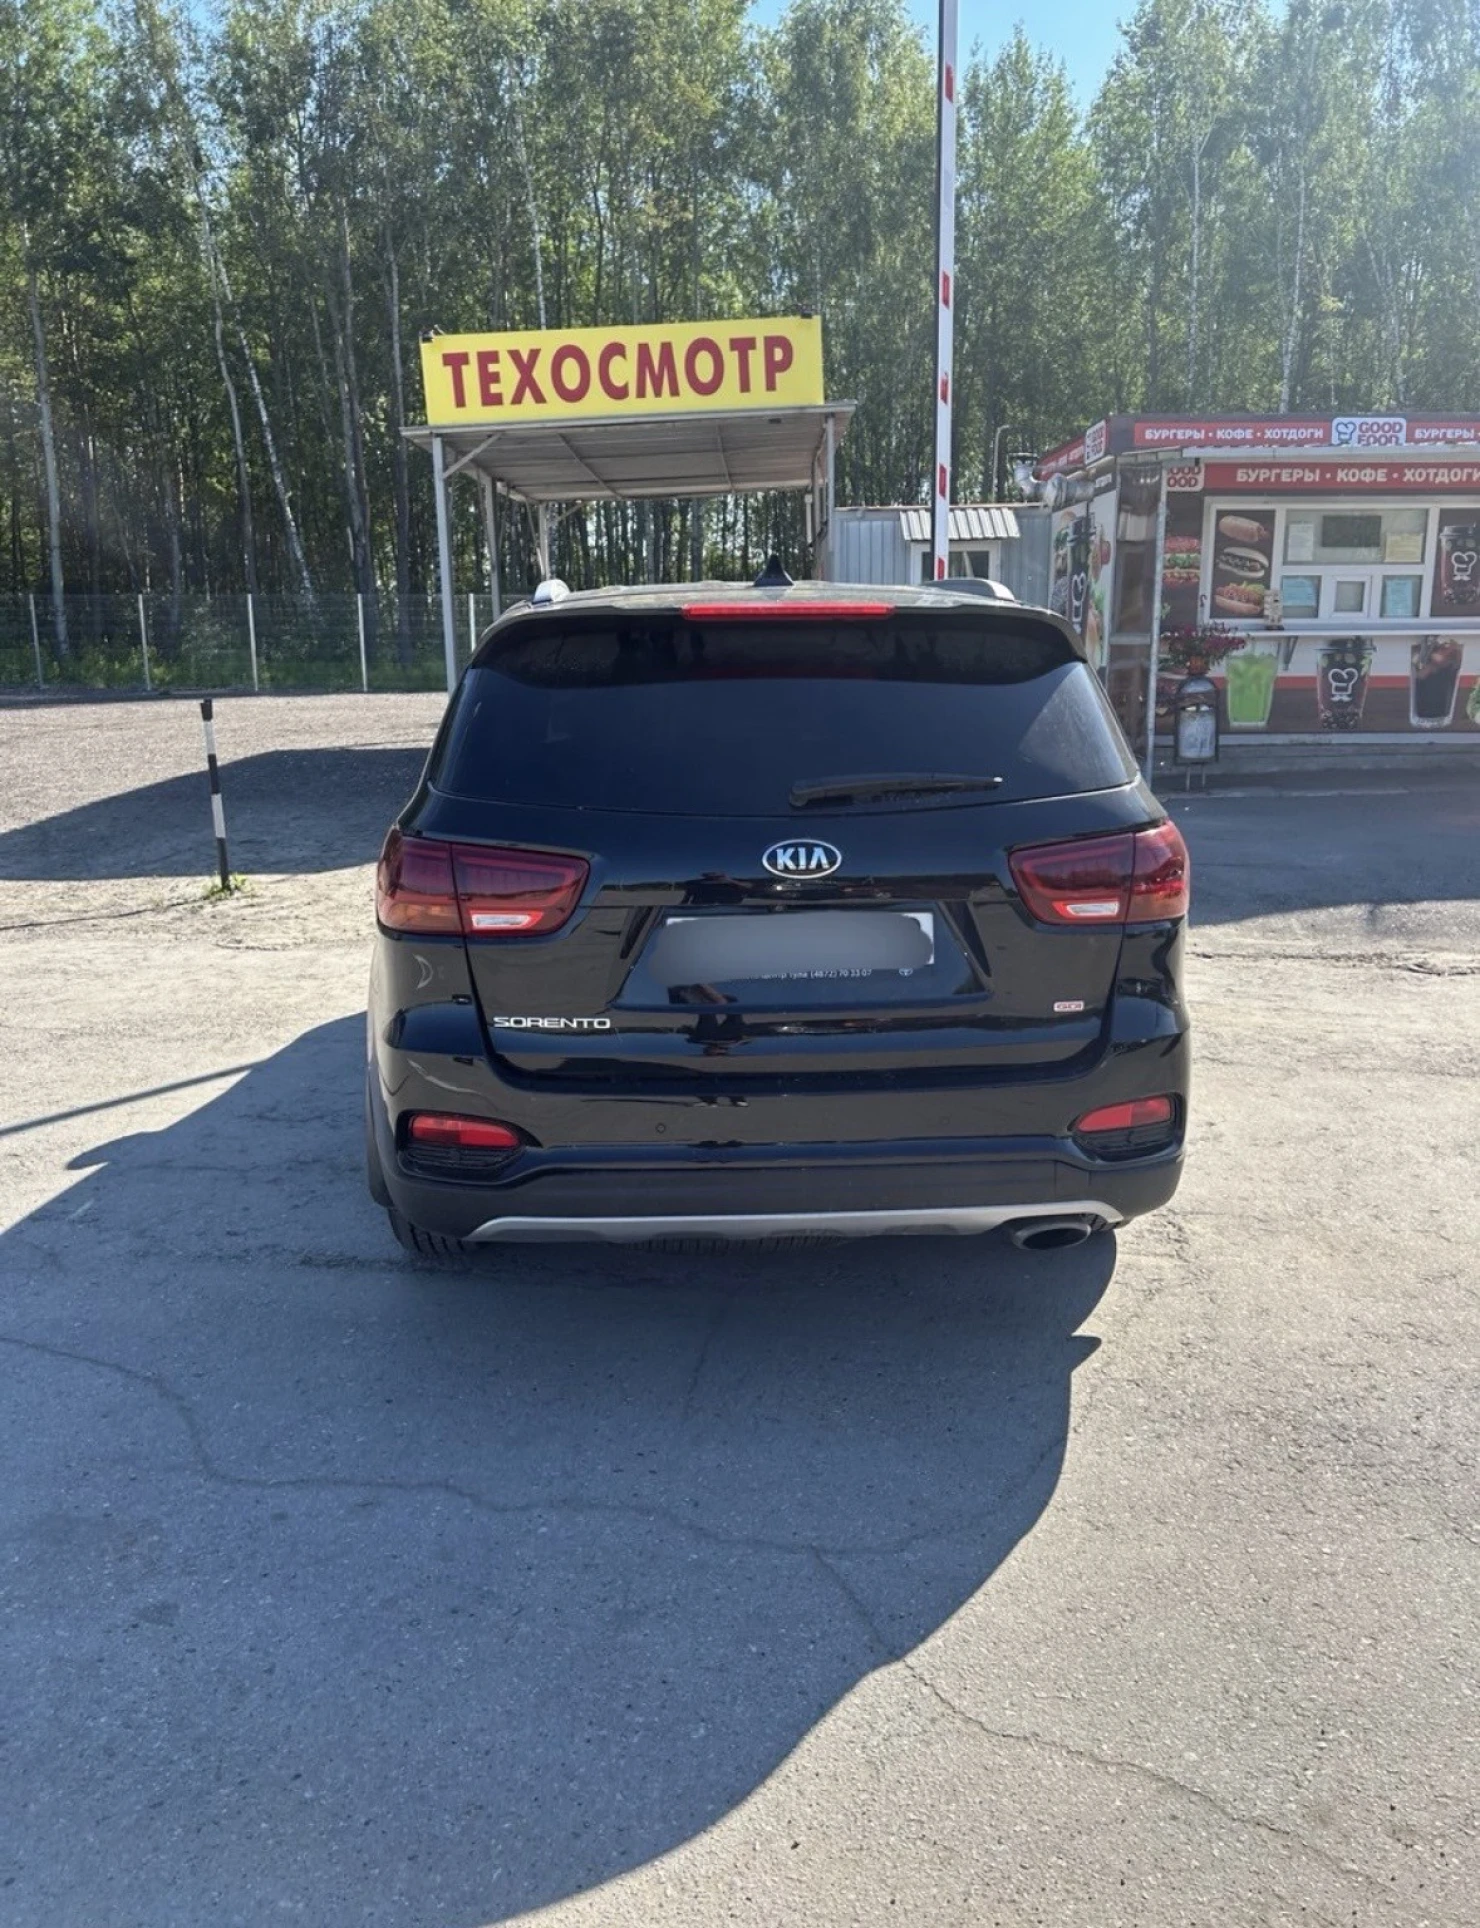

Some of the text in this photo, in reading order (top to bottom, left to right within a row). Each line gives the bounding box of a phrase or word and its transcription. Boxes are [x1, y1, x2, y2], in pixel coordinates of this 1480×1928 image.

[442, 335, 794, 408] ТЕХОСМОТР
[1359, 421, 1404, 434] GOOD
[1414, 428, 1475, 439] БУРГЕРЫ
[1144, 428, 1324, 441] БУРГЕРЫ КОФЕ ХОТДОГИ
[1236, 468, 1320, 482] БУРГЕРЫ
[1336, 468, 1388, 482] КОФЕ
[776, 846, 830, 871] KIA
[493, 1017, 611, 1029] SORENTO
